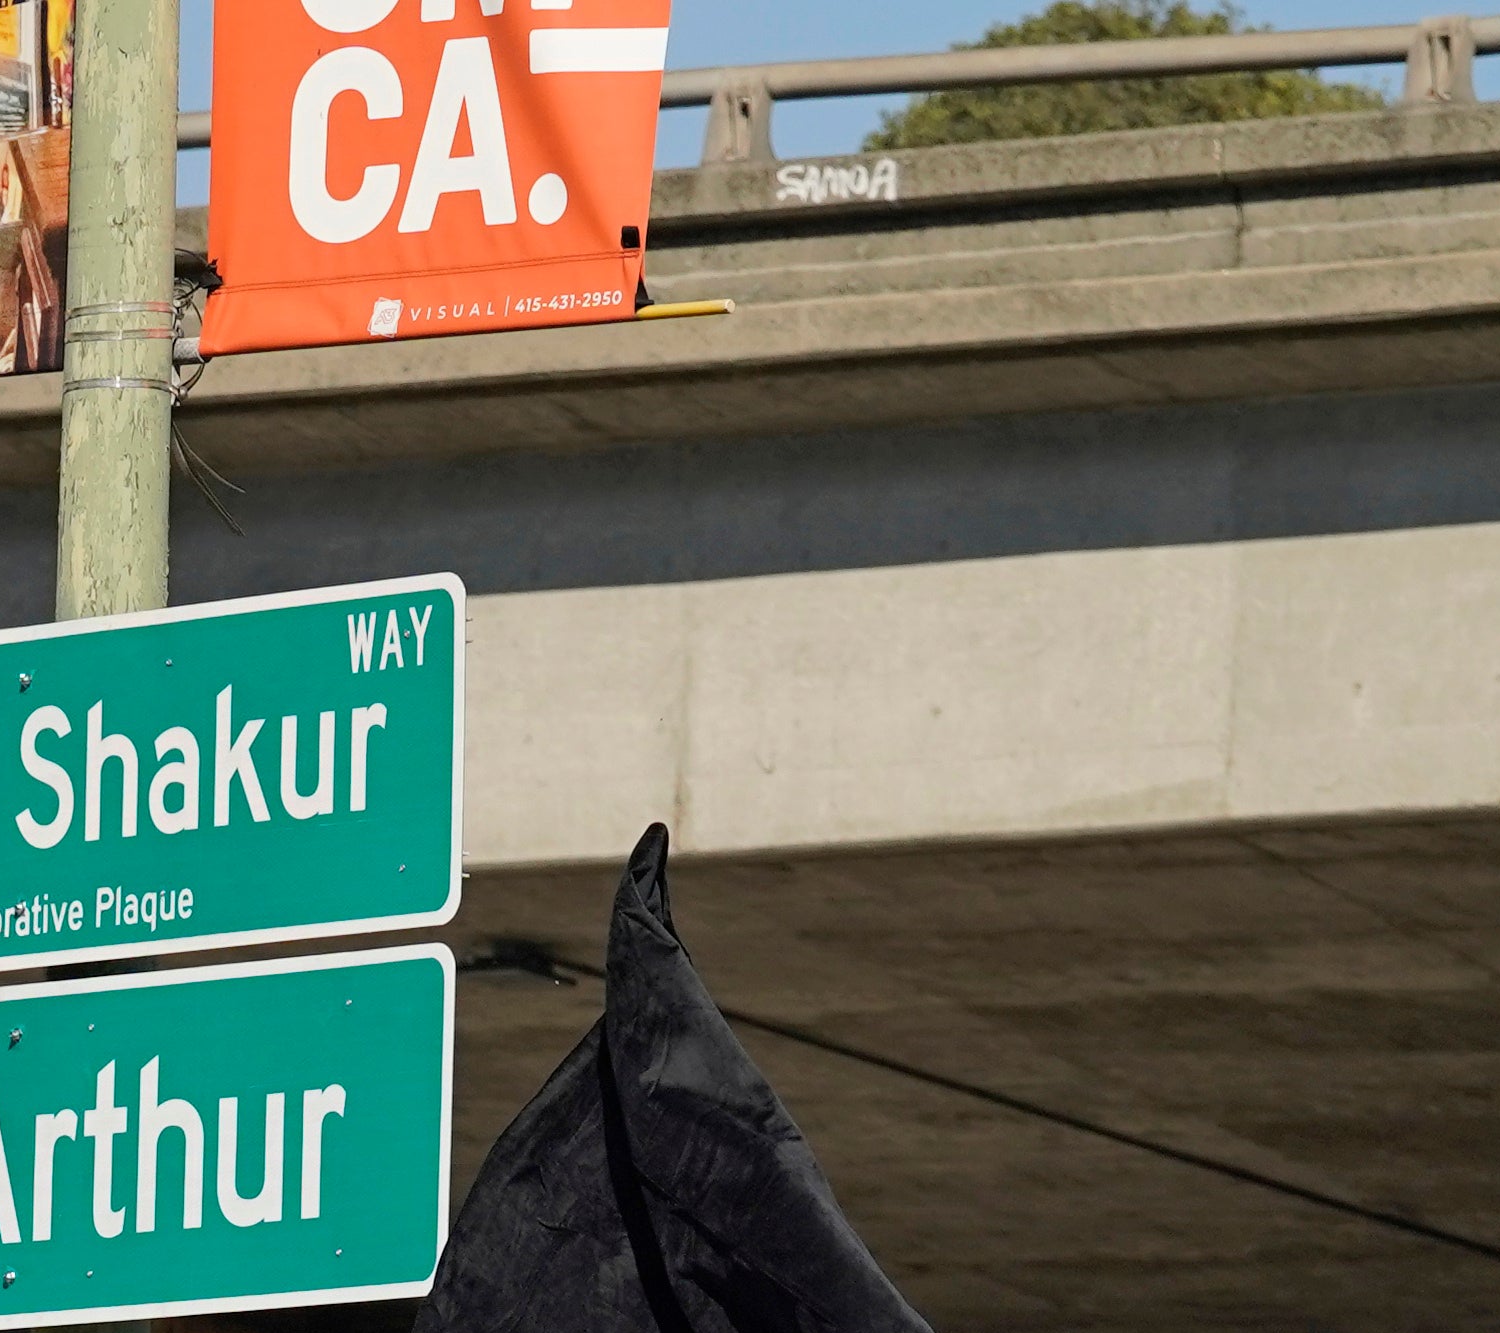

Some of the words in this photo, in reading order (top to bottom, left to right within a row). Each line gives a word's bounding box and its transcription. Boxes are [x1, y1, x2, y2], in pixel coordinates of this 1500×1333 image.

[289, 36, 568, 243] CA.
[410, 302, 495, 322] VISUAL
[514, 289, 623, 313] 415-431-2950
[347, 604, 433, 674] WAY
[15, 684, 387, 849] Shakur
[95, 886, 194, 932] Plaque
